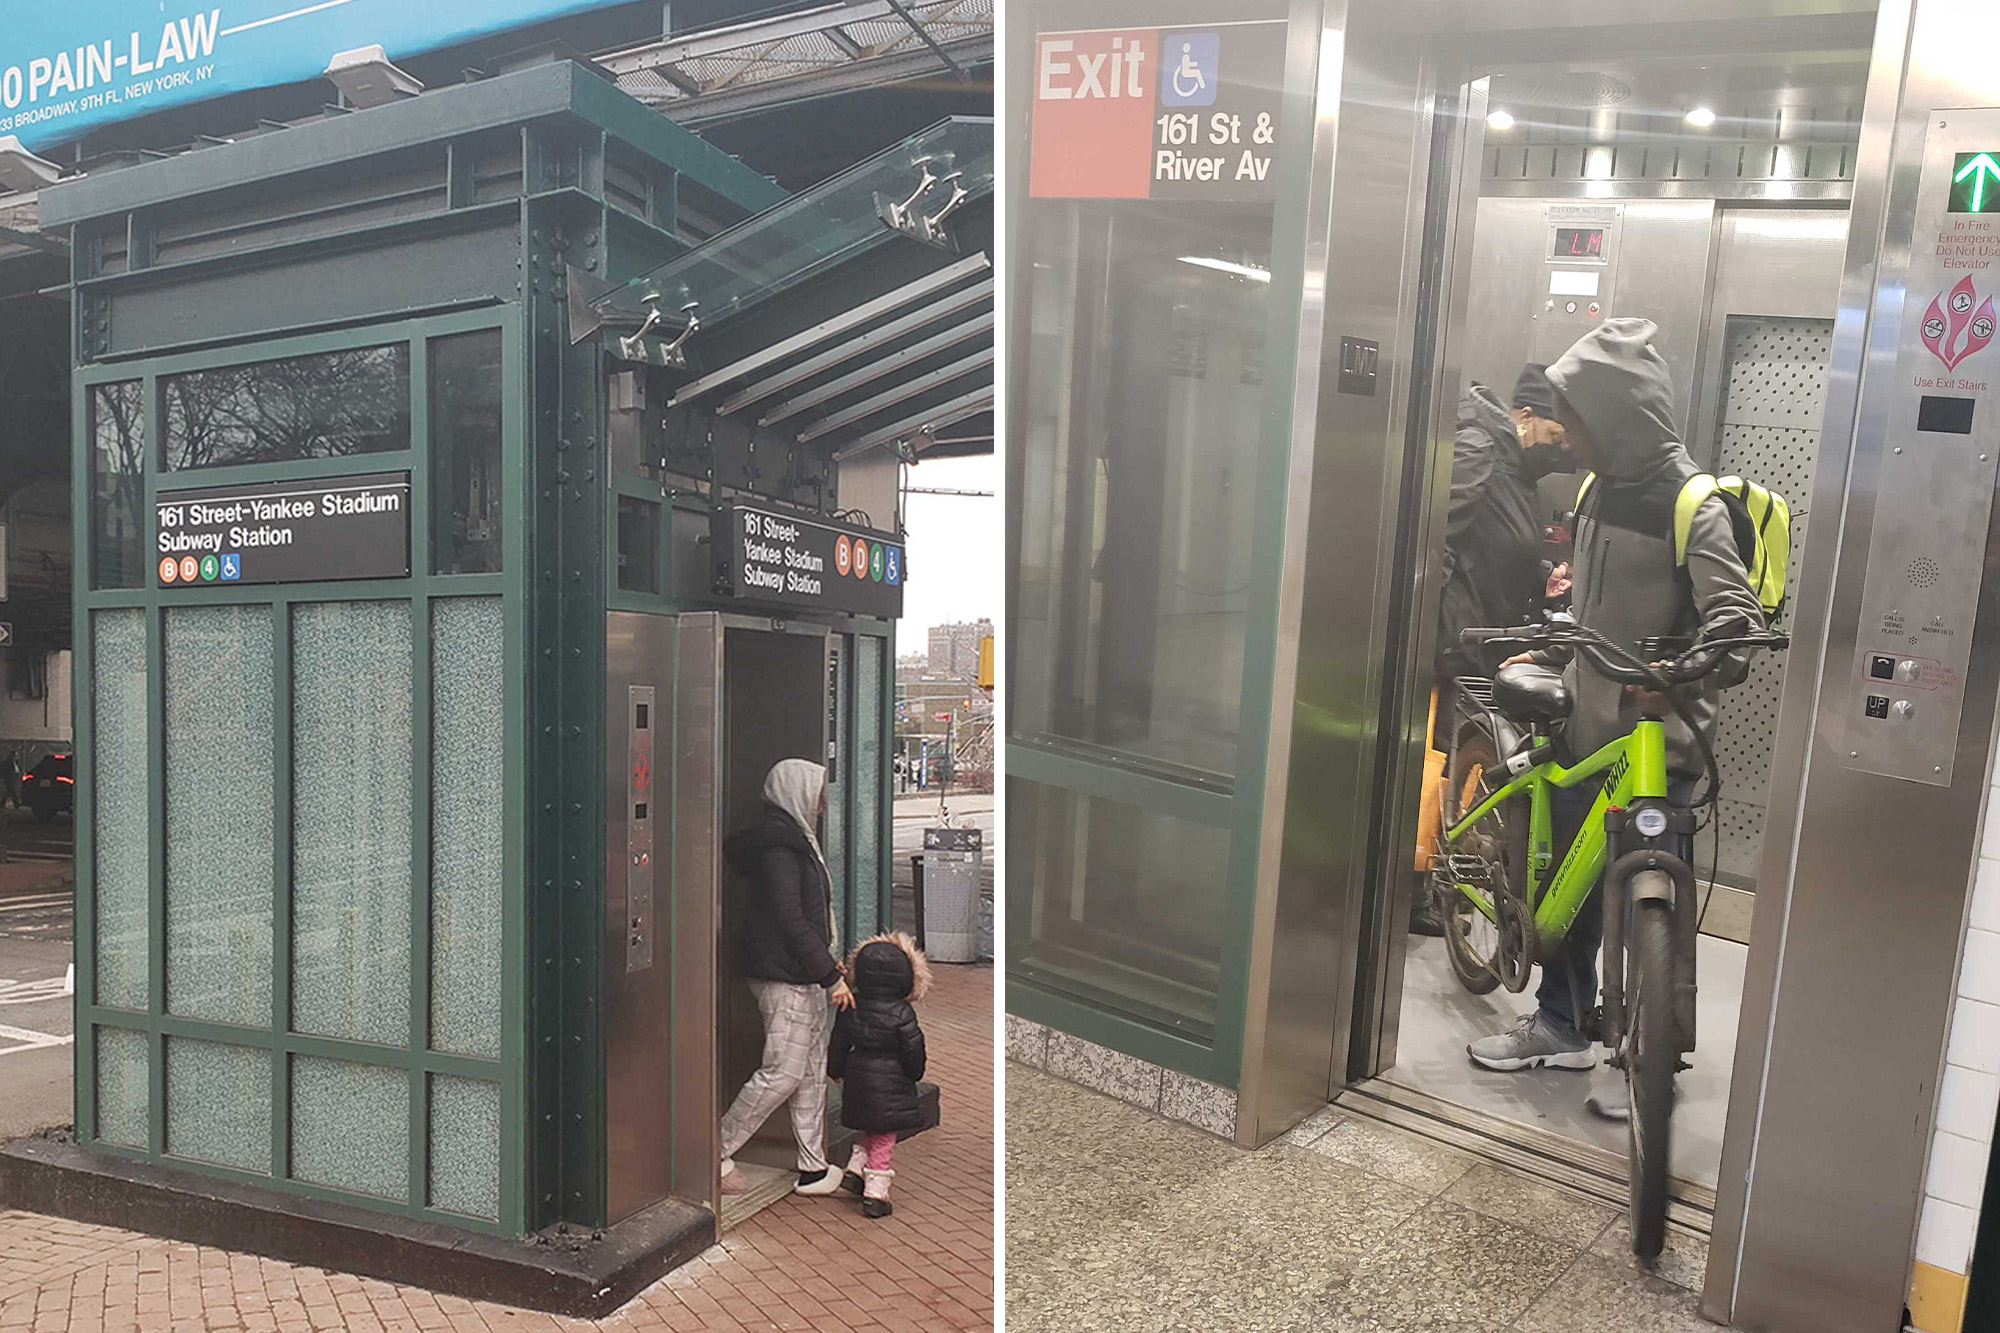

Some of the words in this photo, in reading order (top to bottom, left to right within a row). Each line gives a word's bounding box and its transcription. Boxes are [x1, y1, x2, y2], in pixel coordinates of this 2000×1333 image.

[0, 66, 22, 108] 0
[29, 9, 221, 102] PAIN-LAW
[1039, 37, 1145, 100] Exit
[15, 101, 79, 127] BROADWAY,
[80, 93, 103, 111] 9TH
[125, 80, 153, 99] NEW
[155, 70, 194, 91] YORK,
[196, 64, 215, 81] NY
[1157, 113, 1198, 145] 161
[1209, 112, 1241, 145] St
[1252, 112, 1274, 144] &
[1155, 150, 1225, 181] River
[1234, 150, 1271, 181] Av
[1939, 232, 2000, 246] Emergency
[1955, 220, 1964, 230] In
[1969, 220, 1990, 230] Fire
[1936, 245, 1952, 256] Do
[1956, 246, 1975, 256] Not
[1979, 246, 2000, 256] Use
[1943, 257, 1991, 269] Elevator
[1914, 376, 1933, 388] Use
[1936, 377, 1955, 389] Exit
[1957, 379, 1988, 391] Stairs
[158, 506, 184, 528] 161
[190, 498, 315, 526] Street-Yankee
[321, 491, 399, 516] Stadium
[158, 531, 223, 552] Subway
[229, 526, 292, 548] Station
[744, 513, 761, 536] 161
[764, 517, 800, 543] Street-
[744, 538, 782, 566] Yankee
[784, 546, 823, 572] Stadium
[744, 564, 785, 594] Subway
[787, 571, 822, 595] Station
[1870, 696, 1886, 709] UP
[1604, 750, 1630, 800] WHIZZ
